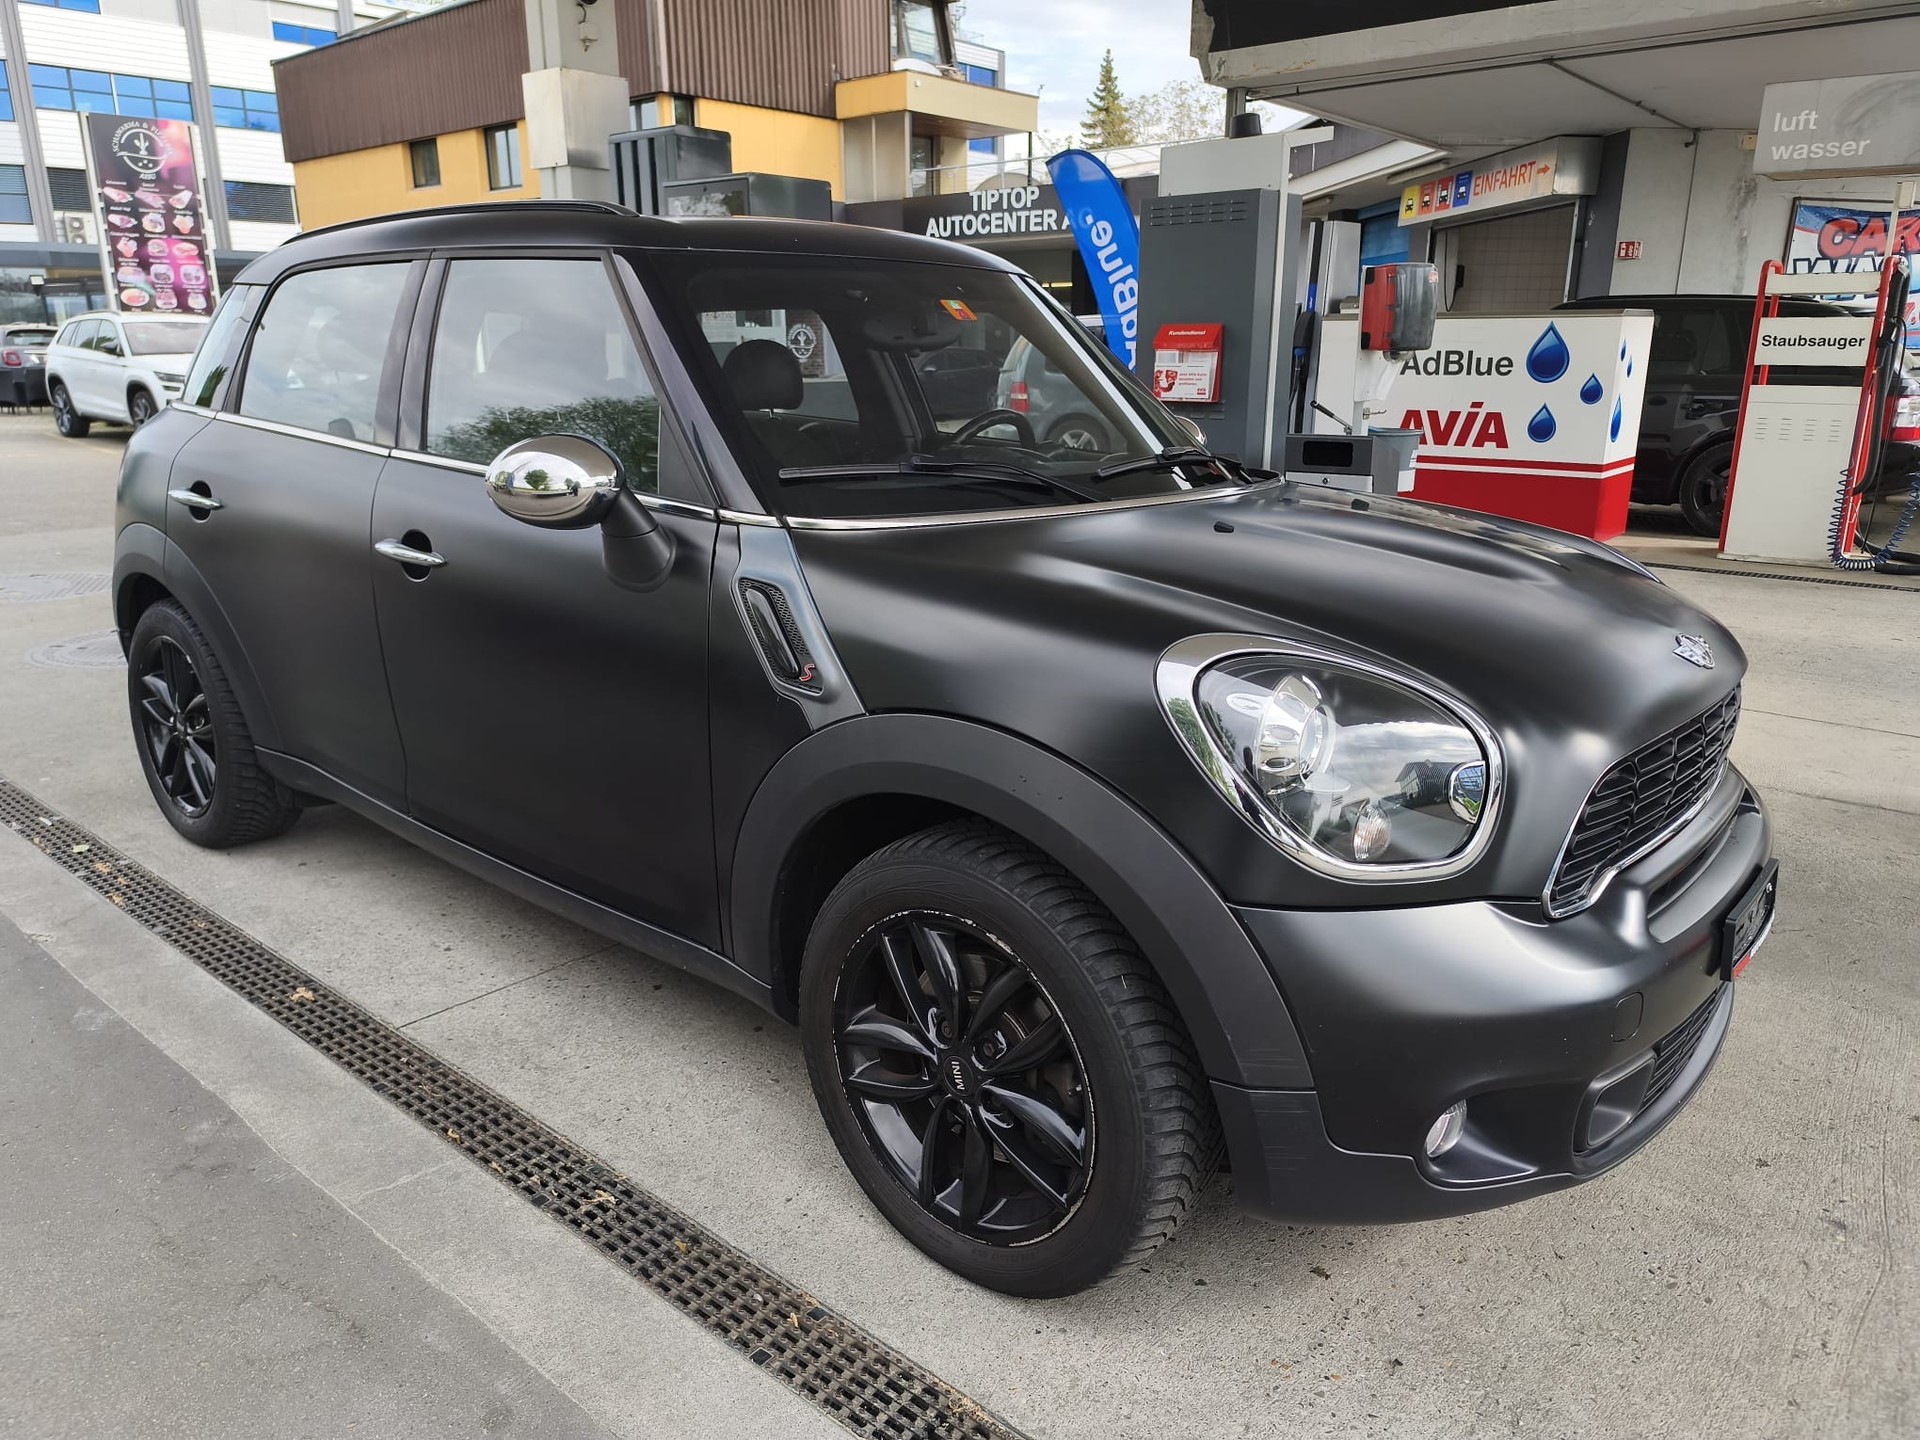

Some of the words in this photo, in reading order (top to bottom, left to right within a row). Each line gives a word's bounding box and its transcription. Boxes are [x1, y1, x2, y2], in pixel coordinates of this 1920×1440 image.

[1773, 110, 1818, 132] luft
[1771, 139, 1871, 160] wasser
[1473, 161, 1536, 197] EINFAHRT
[969, 186, 1040, 211] TIPTOP
[925, 208, 1058, 238] AUTOCENTER
[1761, 334, 1865, 350] Staubsauger
[1400, 350, 1514, 376] AdBlue
[1400, 401, 1509, 448] AVIA
[799, 663, 816, 682] S
[951, 1061, 965, 1090] MINI
